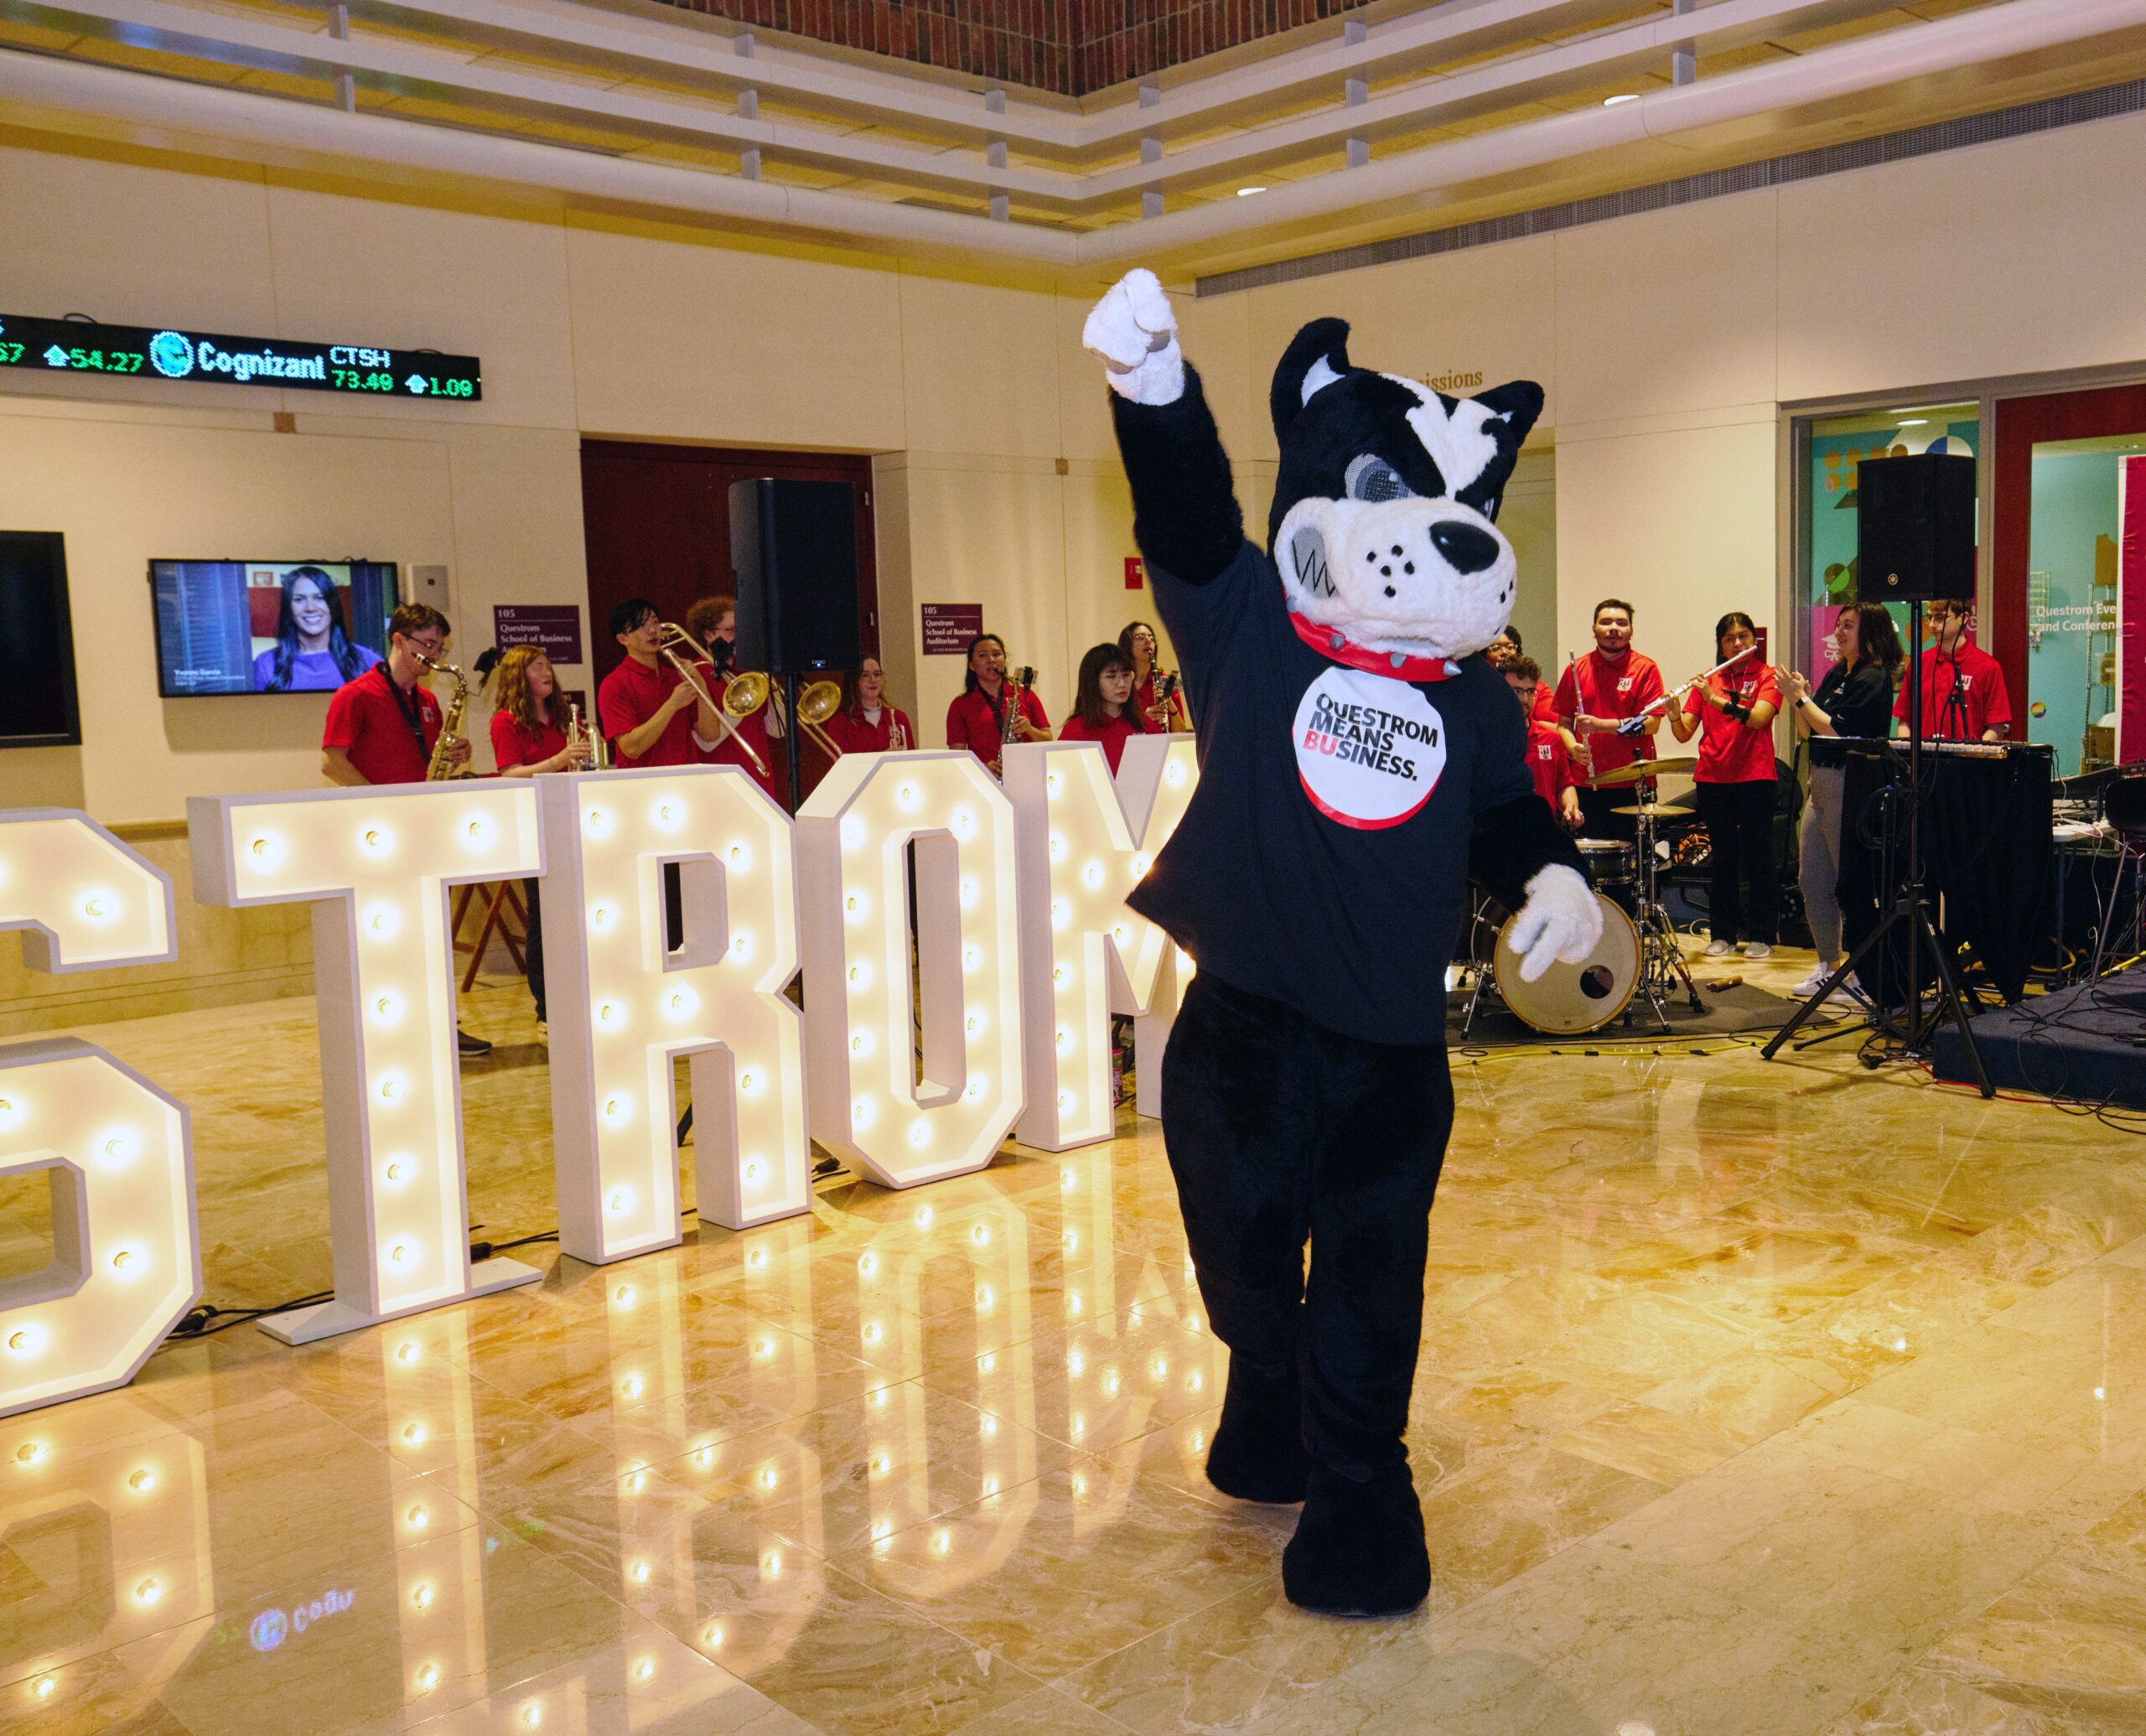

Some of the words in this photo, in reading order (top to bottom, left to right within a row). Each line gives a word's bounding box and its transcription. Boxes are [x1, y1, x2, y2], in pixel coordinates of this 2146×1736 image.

[70, 348, 145, 373] 54.27
[329, 345, 391, 368] CTSH
[429, 377, 474, 397] 1.09
[1418, 370, 1483, 391] issions
[498, 609, 516, 618] 105
[2035, 604, 2093, 617] Questrom
[500, 624, 541, 634] Questrom
[2039, 621, 2060, 631] and
[500, 634, 528, 643] School
[530, 634, 537, 642] of
[539, 634, 572, 643] Business
[1315, 692, 1438, 749] QUESTROM
[1308, 710, 1395, 753] MEANS
[1302, 729, 1418, 782] BUSINESS.
